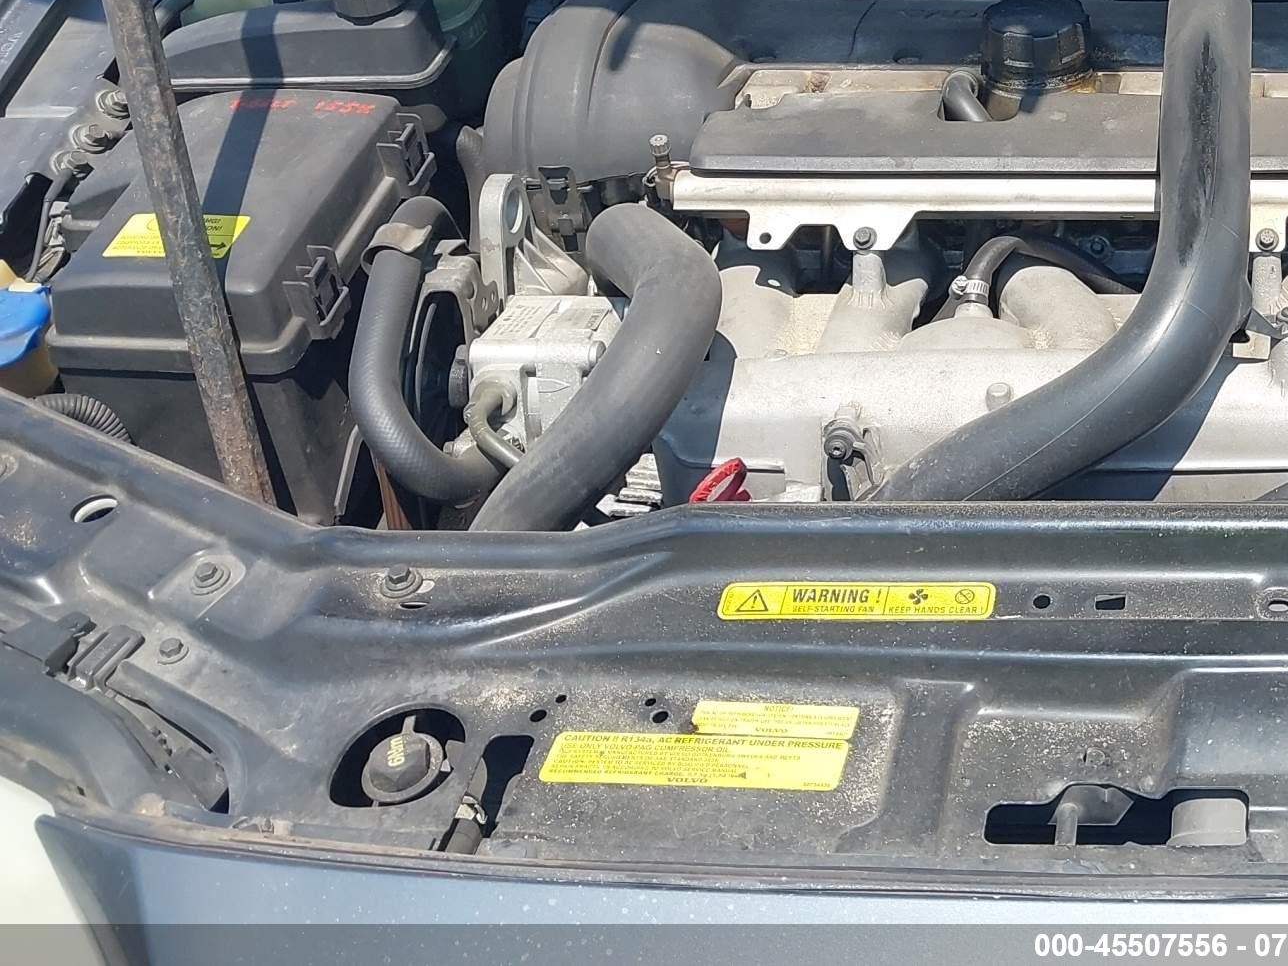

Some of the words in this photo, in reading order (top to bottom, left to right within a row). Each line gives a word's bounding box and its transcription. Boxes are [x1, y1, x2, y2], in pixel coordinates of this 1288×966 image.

[793, 588, 870, 604] WARNING
[793, 605, 856, 613] SELF-STARTING
[889, 606, 911, 614] KEEP
[914, 606, 946, 614] HANDS
[949, 606, 978, 614] CLEAR
[564, 735, 610, 743] CAUTION
[674, 737, 748, 747] REFRIGERANT
[750, 739, 786, 748] UNDER
[787, 741, 844, 750] PRESSURE
[654, 745, 714, 753] COMPRESSOR
